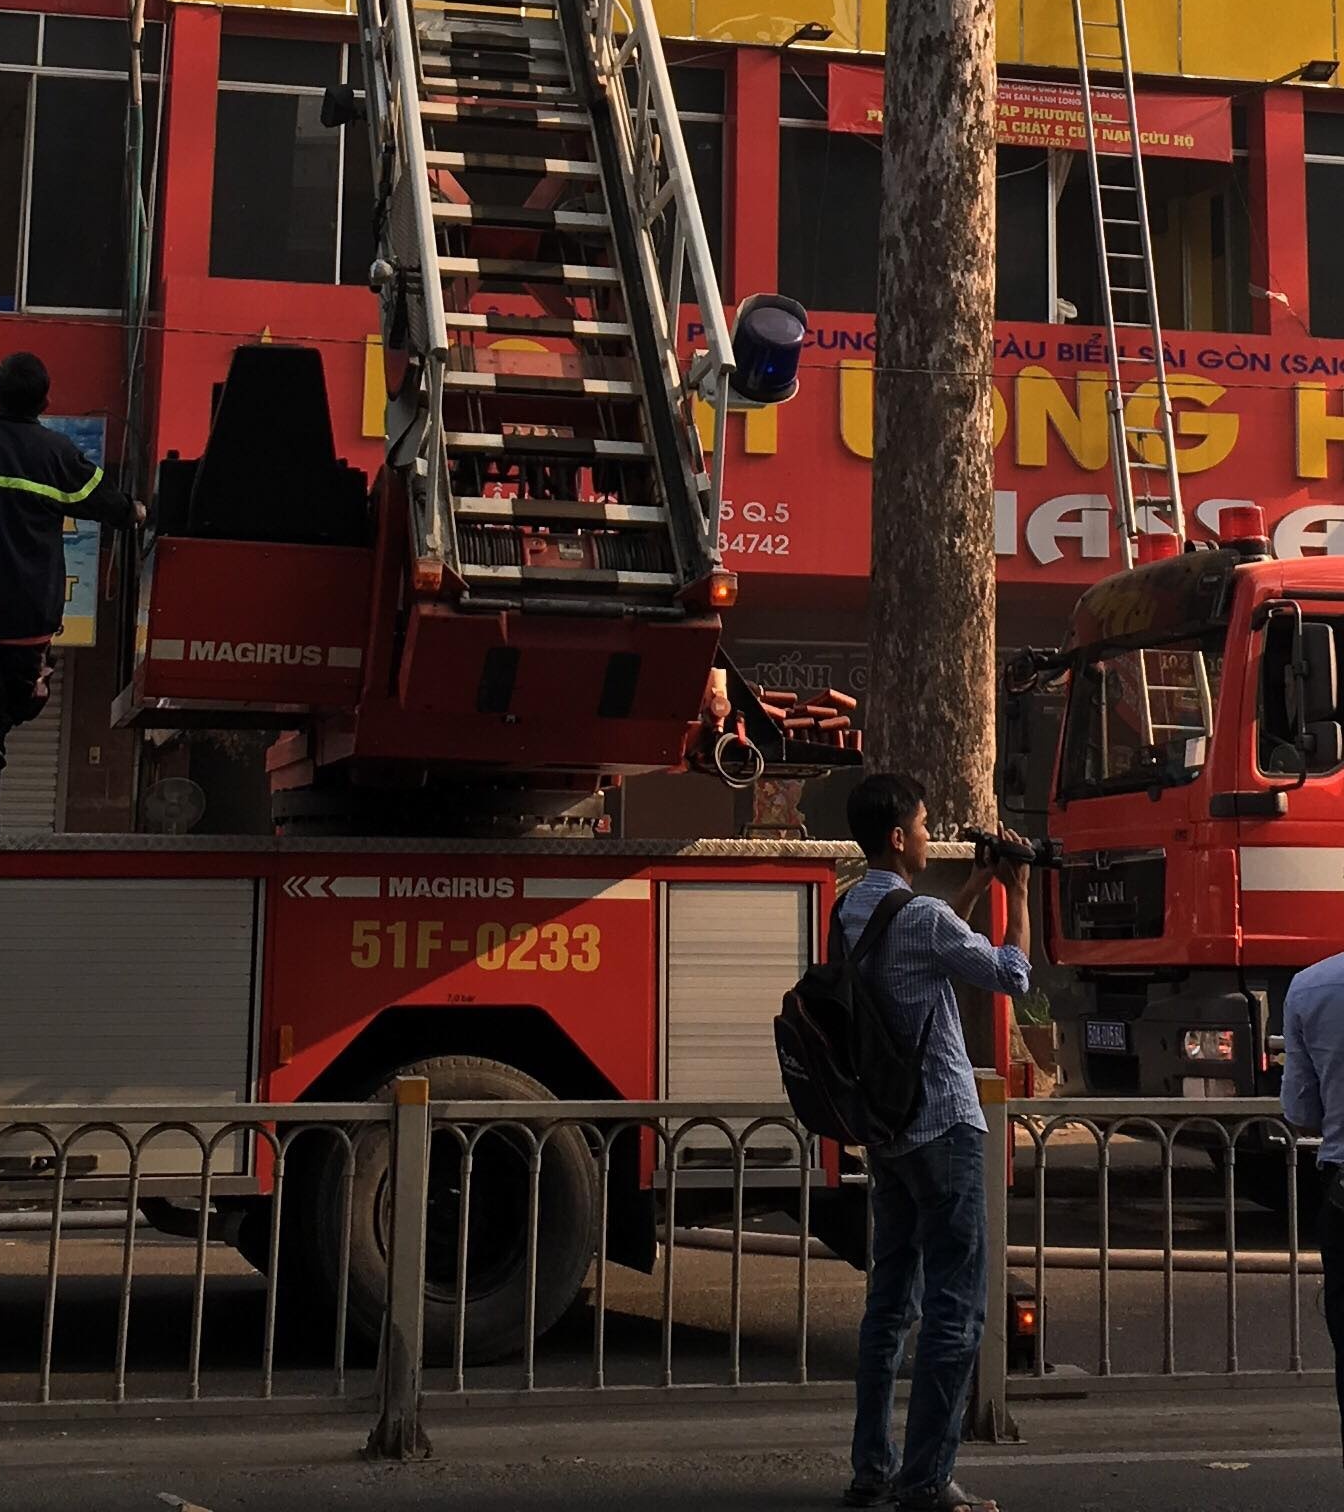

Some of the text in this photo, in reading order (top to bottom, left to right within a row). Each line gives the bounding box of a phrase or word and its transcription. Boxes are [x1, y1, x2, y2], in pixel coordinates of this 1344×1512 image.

[1197, 343, 1272, 372] GÒN
[742, 501, 790, 523] Q.5
[188, 639, 324, 667] MAGIRUS
[387, 876, 515, 899] MAGIRUS
[350, 919, 602, 973] 51F-0233
